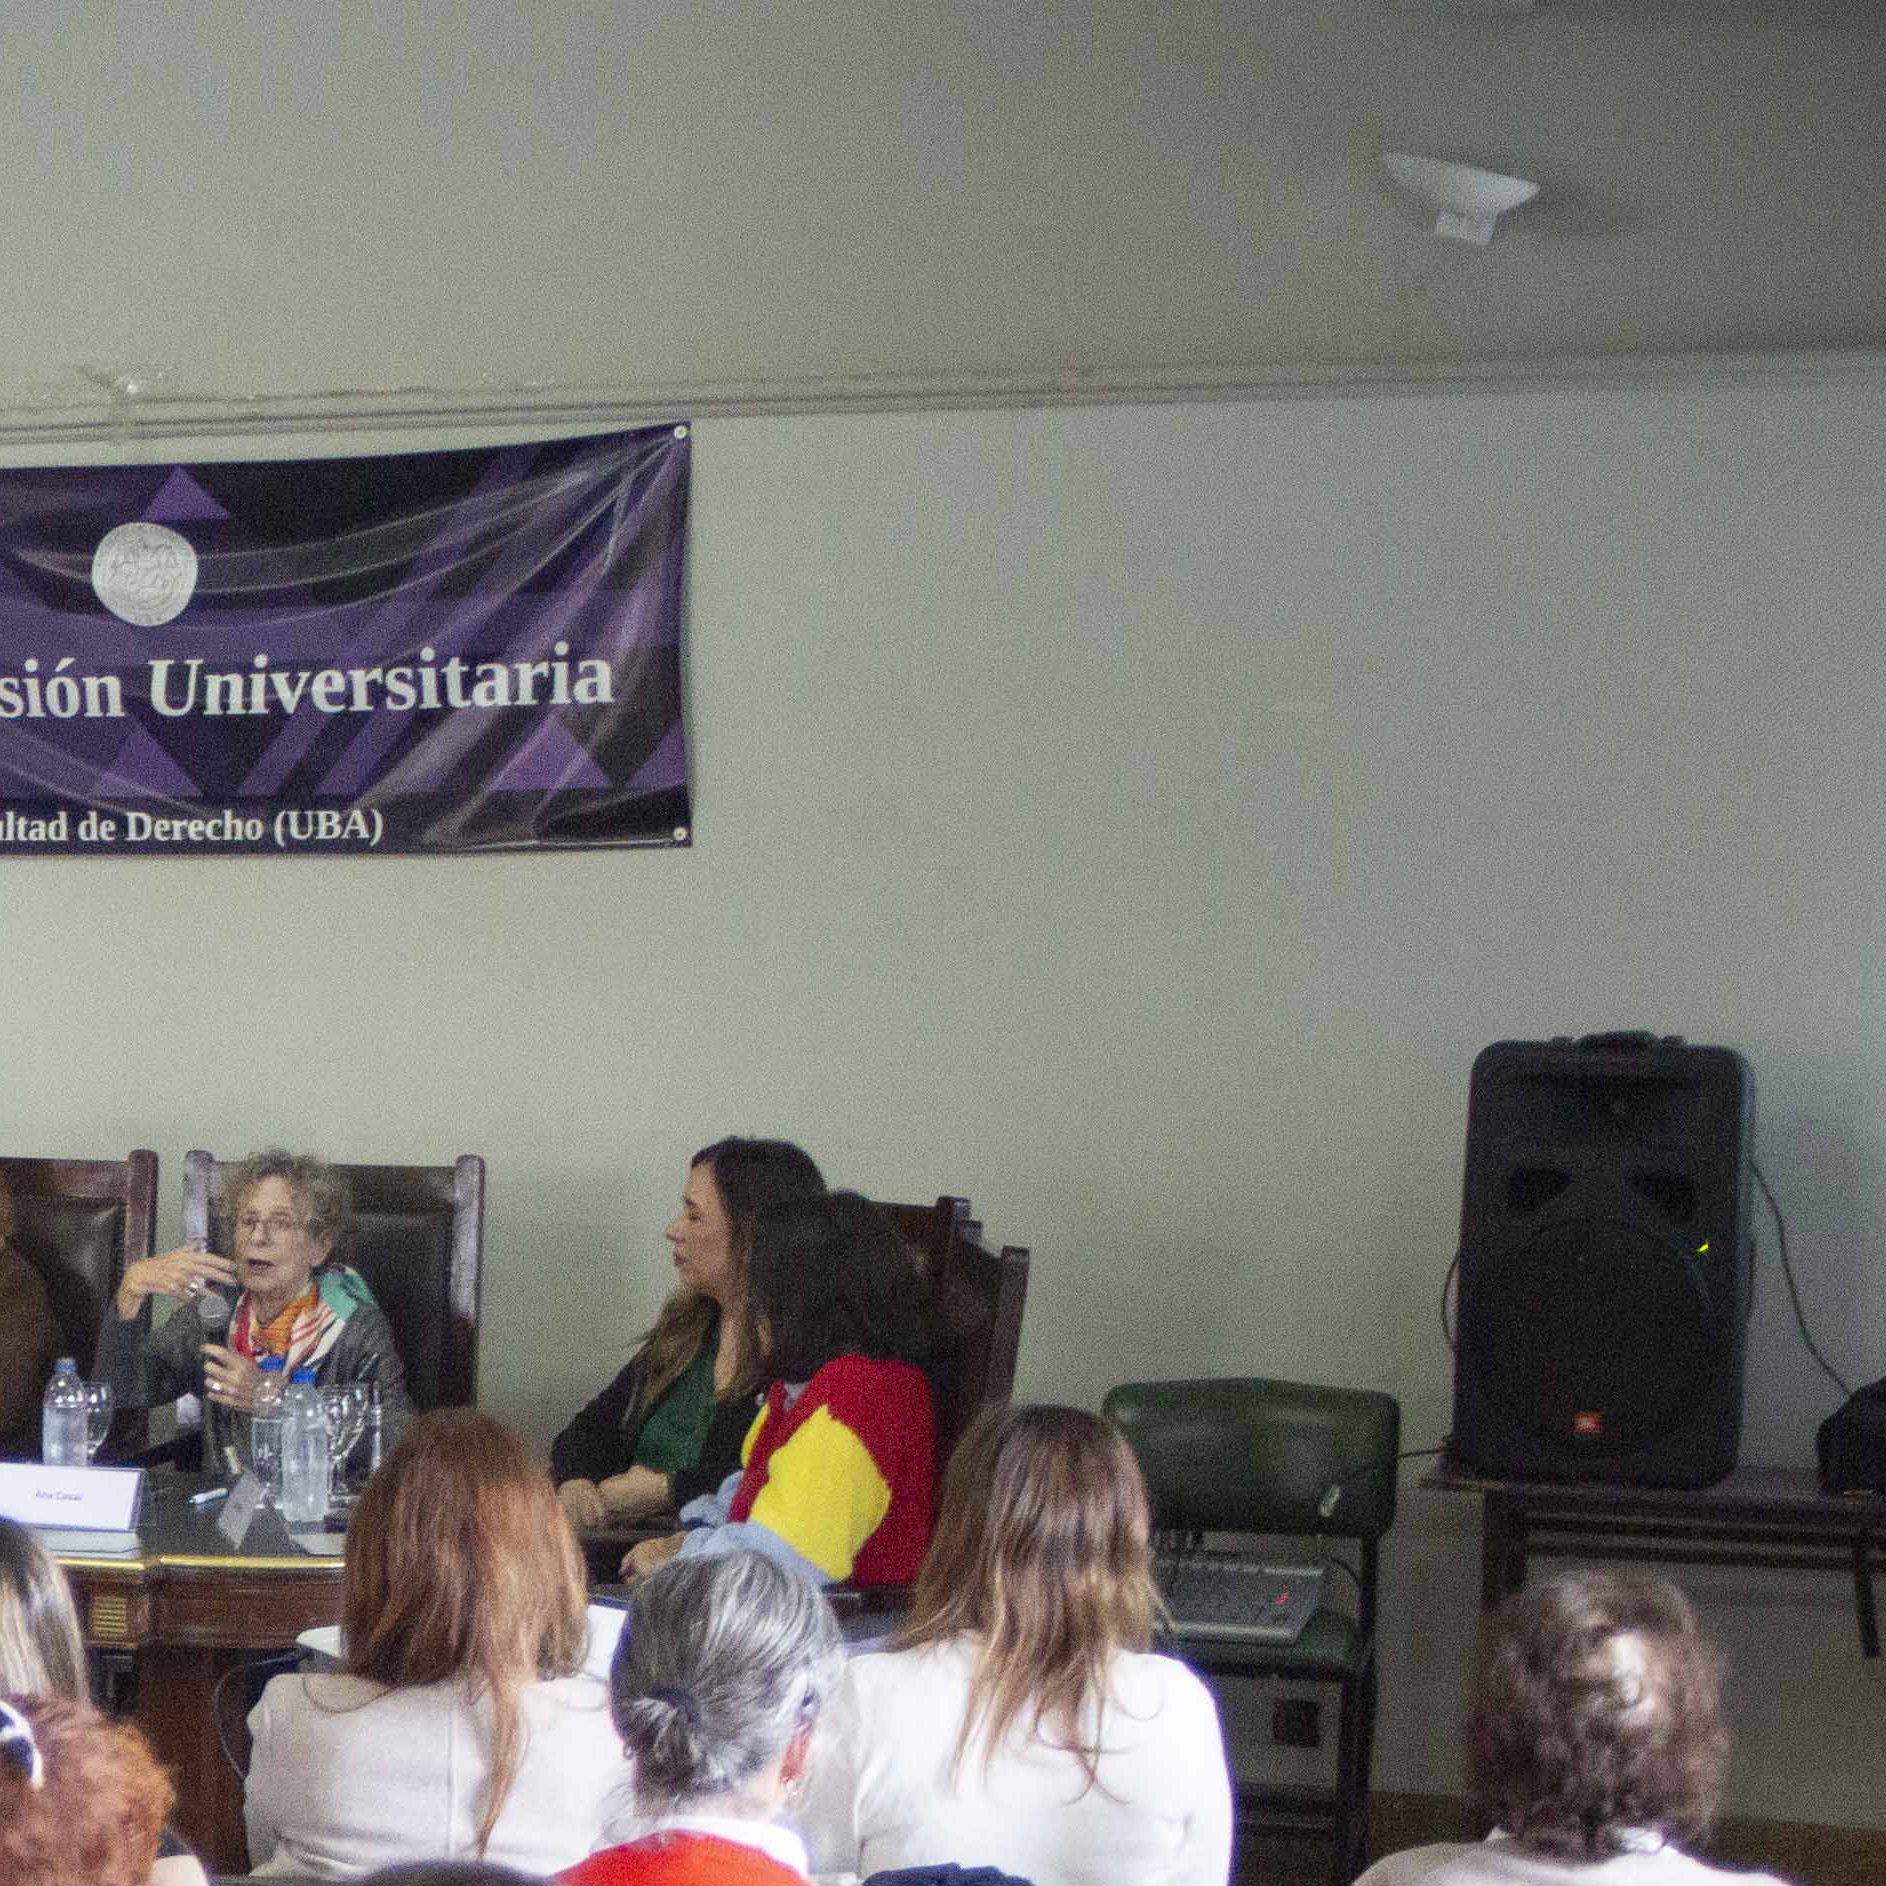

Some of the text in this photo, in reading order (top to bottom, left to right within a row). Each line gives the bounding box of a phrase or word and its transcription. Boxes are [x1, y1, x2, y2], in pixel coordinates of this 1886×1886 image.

[148, 640, 615, 717] Universitaria
[78, 810, 116, 841] de
[125, 809, 263, 842] Derecho
[273, 808, 384, 847] (UBA)
